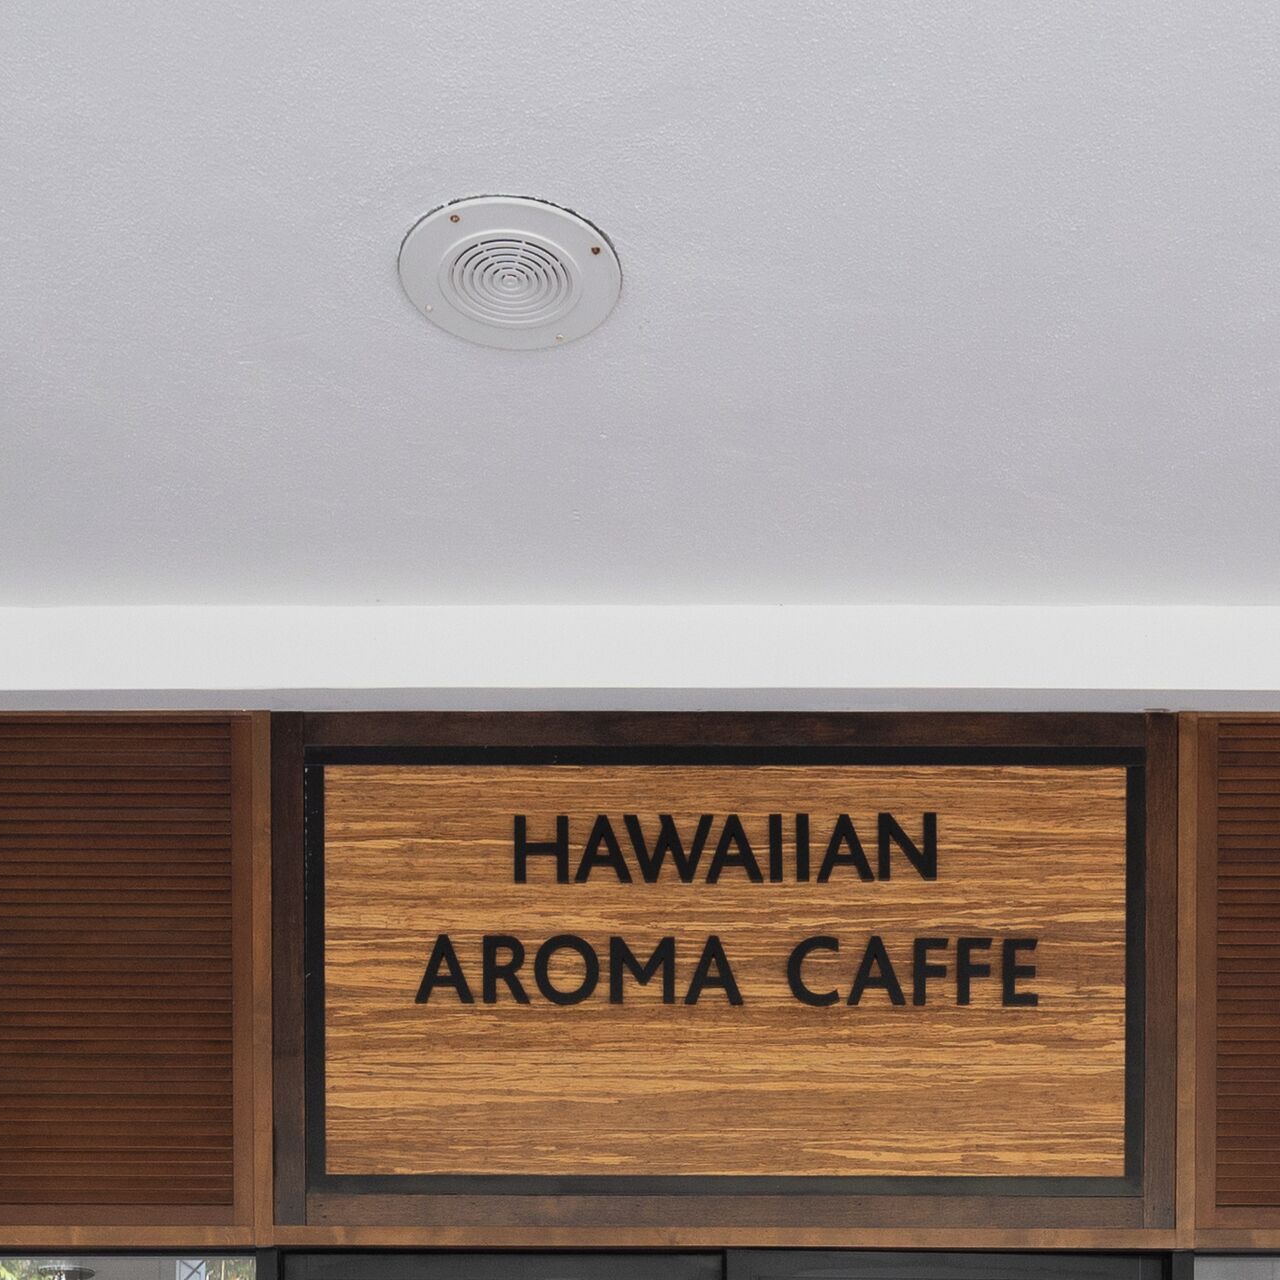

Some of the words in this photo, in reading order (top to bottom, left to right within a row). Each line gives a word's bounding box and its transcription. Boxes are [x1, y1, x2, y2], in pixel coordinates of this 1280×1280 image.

[512, 812, 938, 885] HAWAIIAN
[414, 933, 744, 1007] AROMA
[786, 935, 1040, 1007] CAFFE
